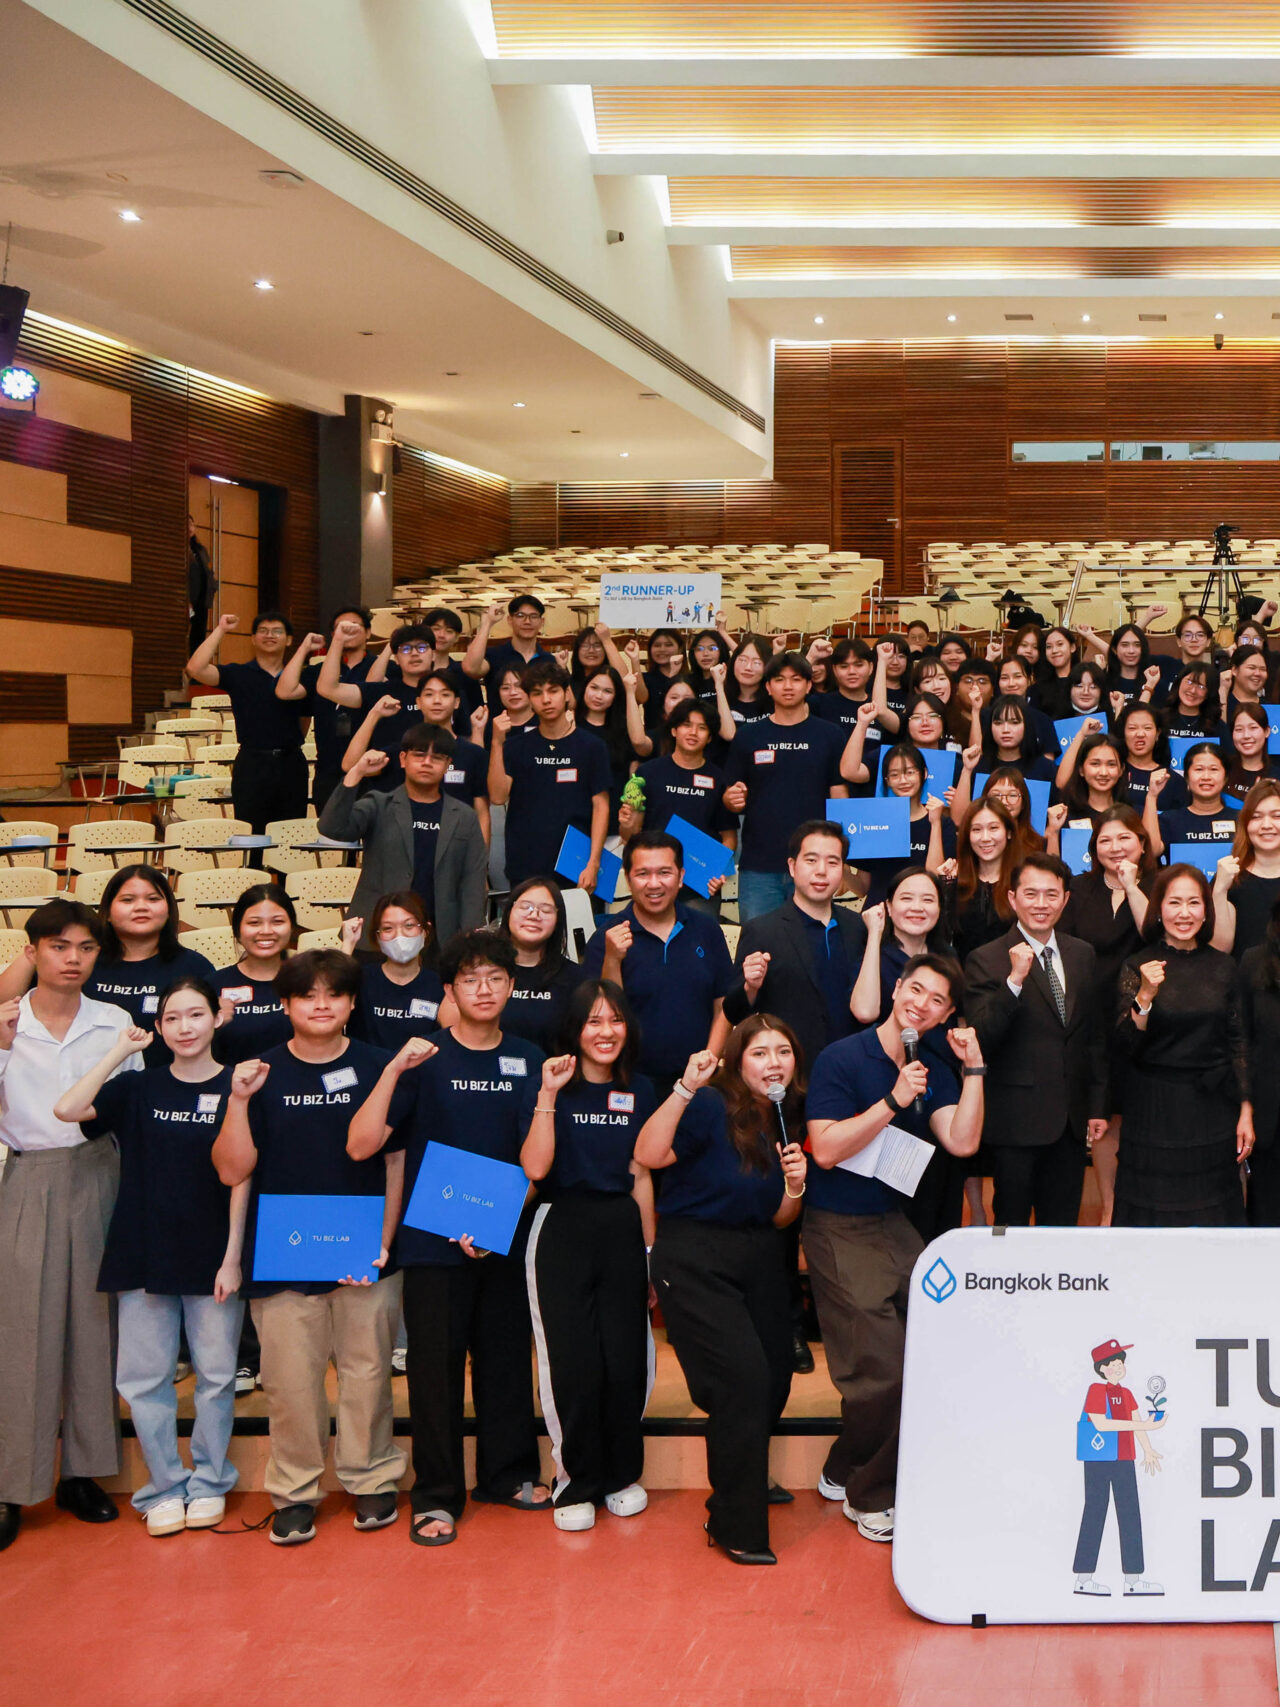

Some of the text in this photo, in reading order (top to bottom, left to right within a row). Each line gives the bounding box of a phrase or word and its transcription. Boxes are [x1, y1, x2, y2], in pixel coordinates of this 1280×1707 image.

[604, 585, 695, 596] 2nd RUNNER-UP
[677, 787, 688, 795] BIZ
[416, 822, 428, 830] BIZ
[1186, 832, 1198, 840] TU
[1198, 832, 1212, 840] BIZ
[910, 843, 925, 851] LAB
[96, 983, 156, 995] TU BIZ LAB
[512, 990, 551, 1000] BIZ LAB
[235, 1005, 272, 1014] TU BIZ
[387, 1009, 403, 1018] BIZ
[451, 1080, 512, 1091] TU BIZ LAB
[283, 1093, 351, 1106] TU BIZ LAB
[153, 1109, 215, 1124] TU BIZ LAB
[572, 1113, 629, 1125] TU BIZ LAB
[470, 1196, 481, 1204] BIZ
[481, 1199, 494, 1208] LAB
[965, 1272, 1109, 1295] Bangkok Bank
[1111, 1396, 1122, 1405] TU
